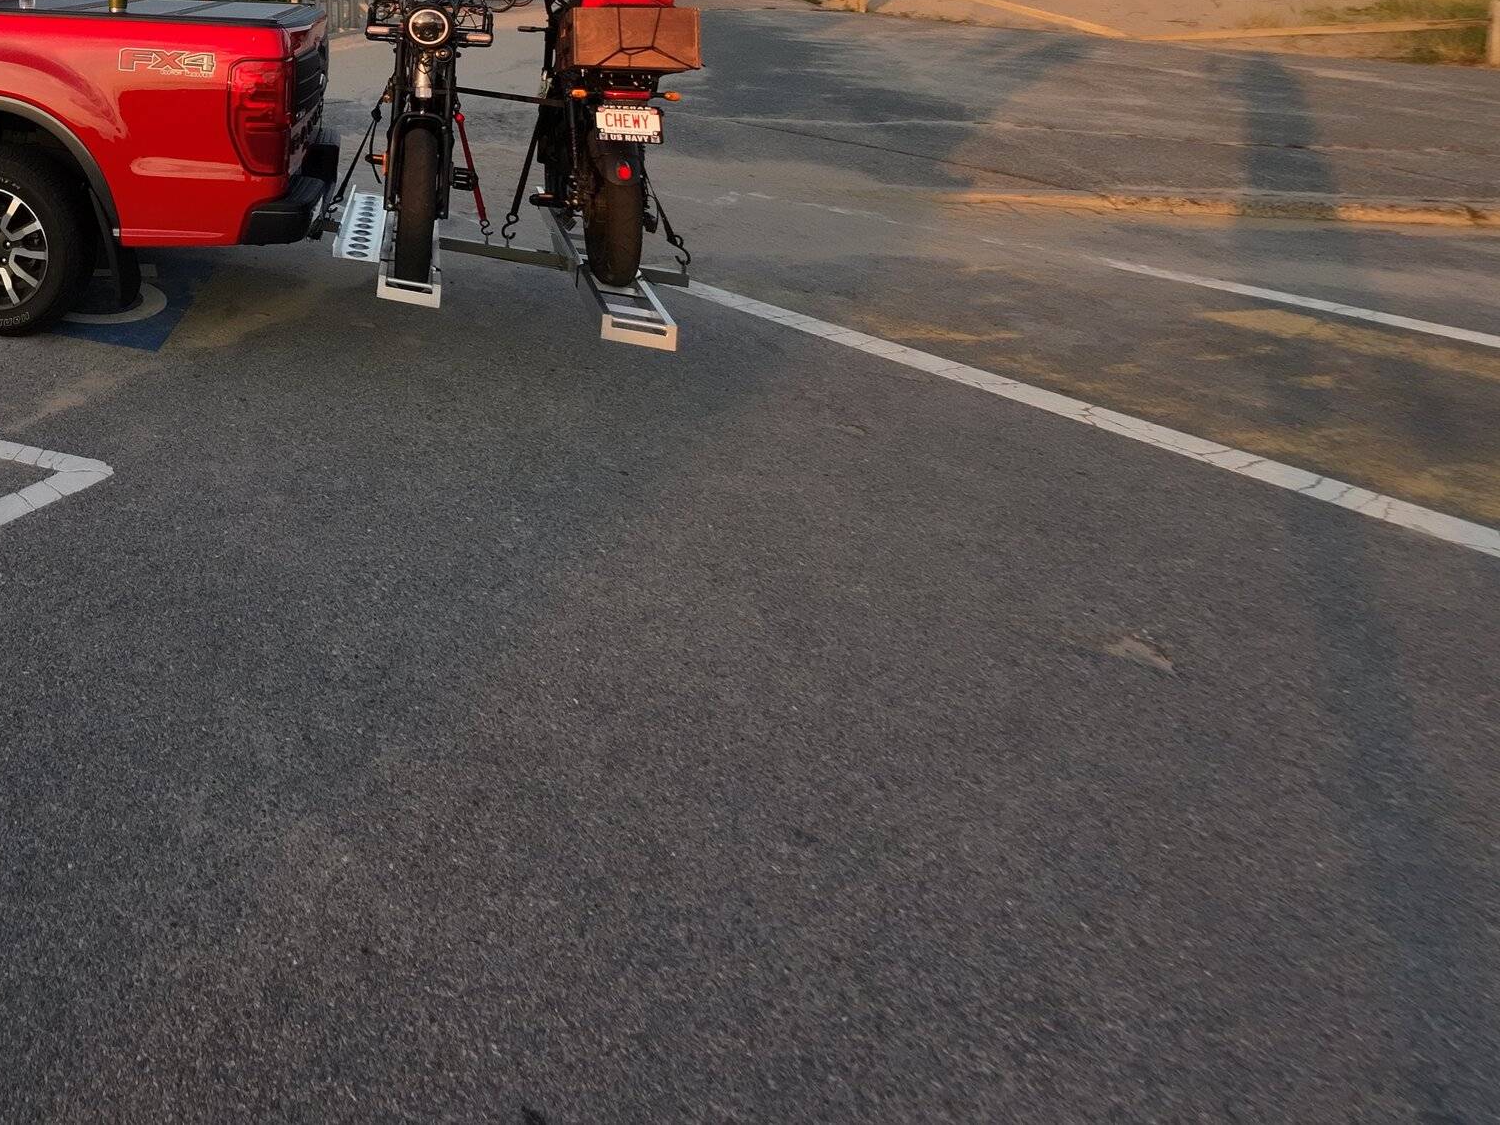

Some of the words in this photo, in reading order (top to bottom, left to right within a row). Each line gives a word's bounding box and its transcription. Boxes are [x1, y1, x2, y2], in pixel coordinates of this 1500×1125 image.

[118, 47, 216, 74] FX4
[605, 112, 649, 128] CHEWY
[625, 134, 649, 142] NAVY
